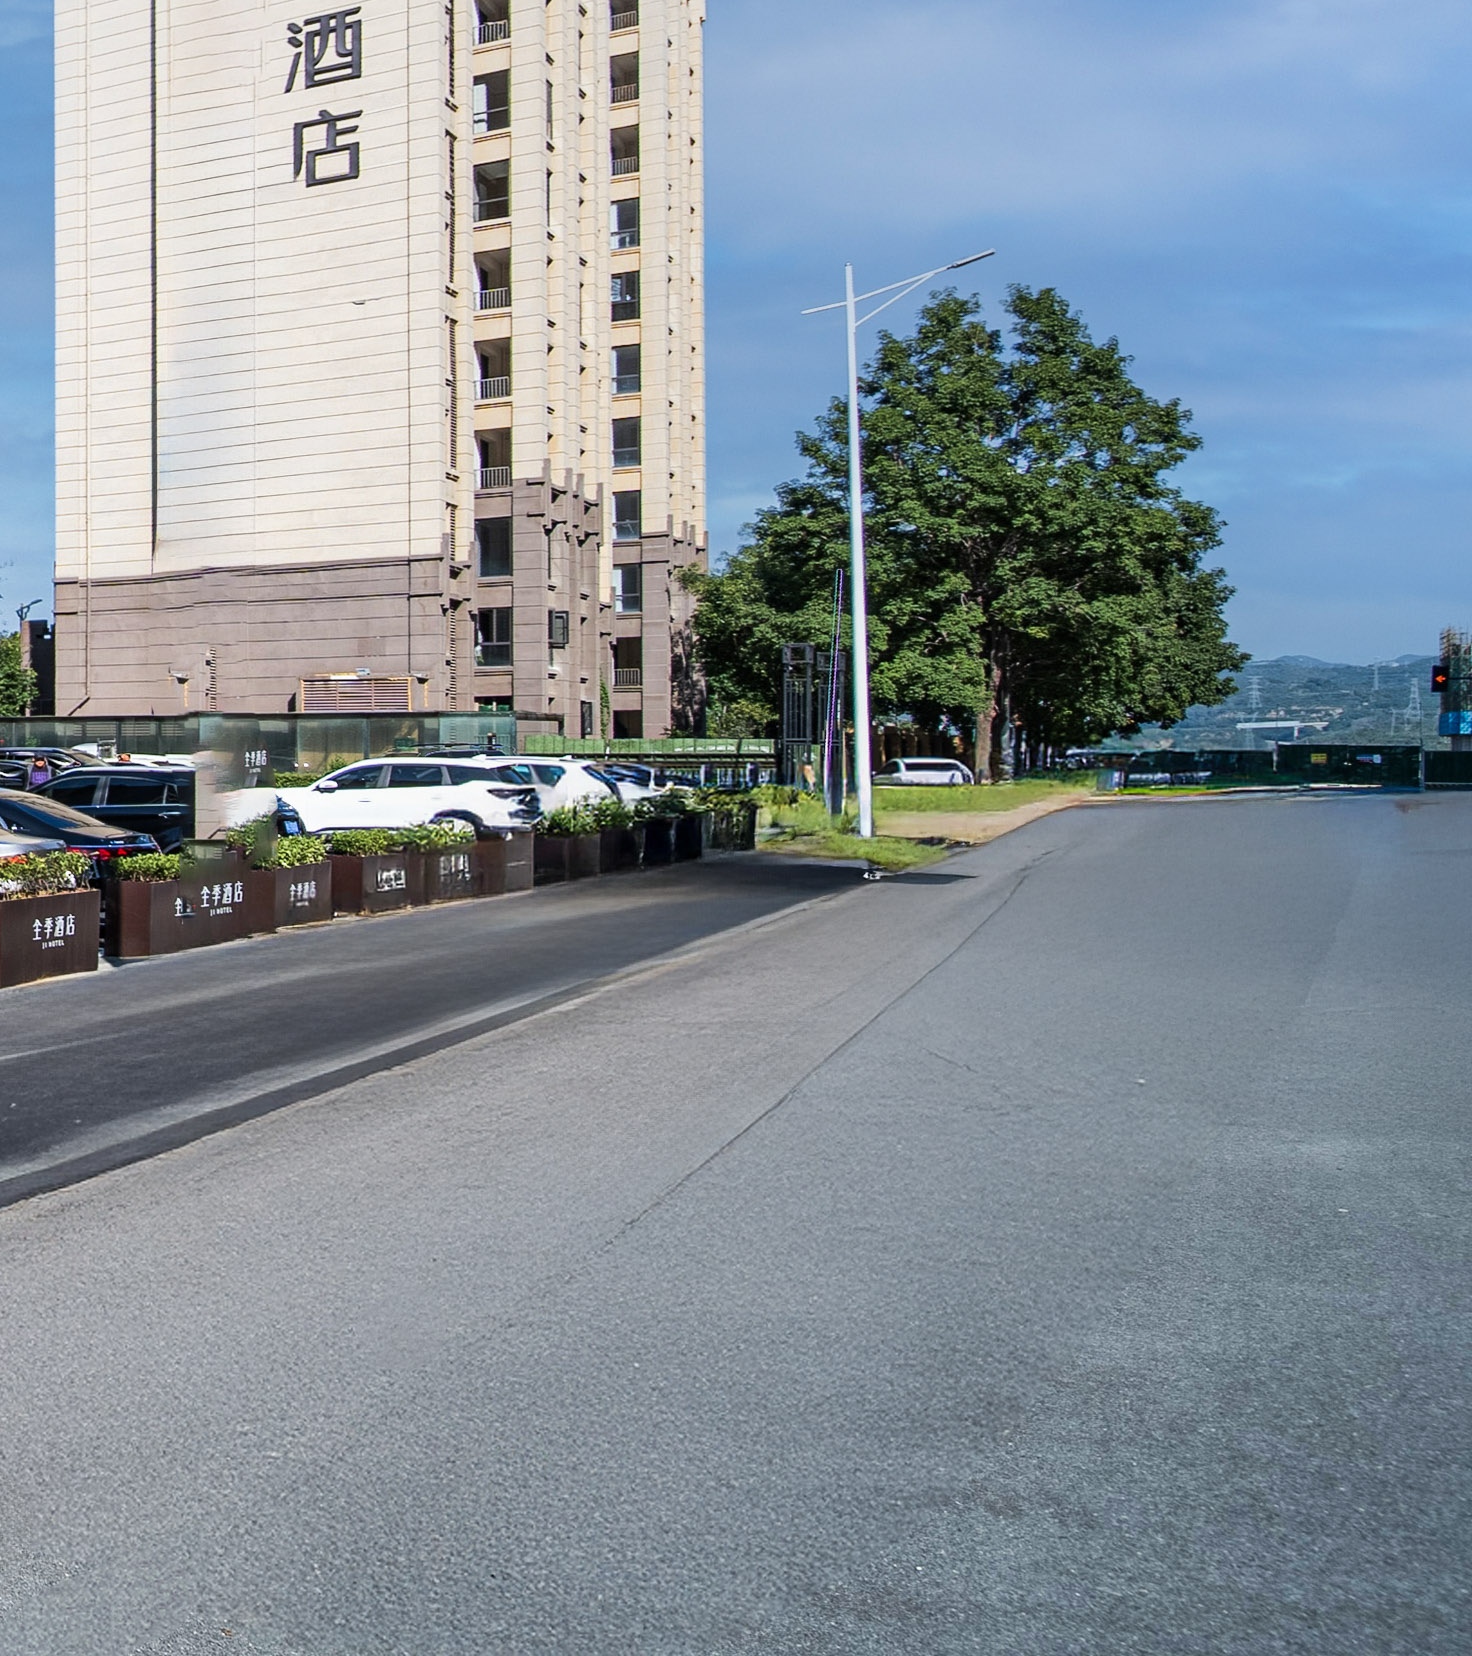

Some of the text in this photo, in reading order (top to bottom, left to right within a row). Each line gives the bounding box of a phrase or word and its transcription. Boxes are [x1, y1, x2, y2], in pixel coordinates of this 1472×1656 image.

[200, 880, 243, 908] 全季酒店
[32, 913, 76, 941] 全季酒店
